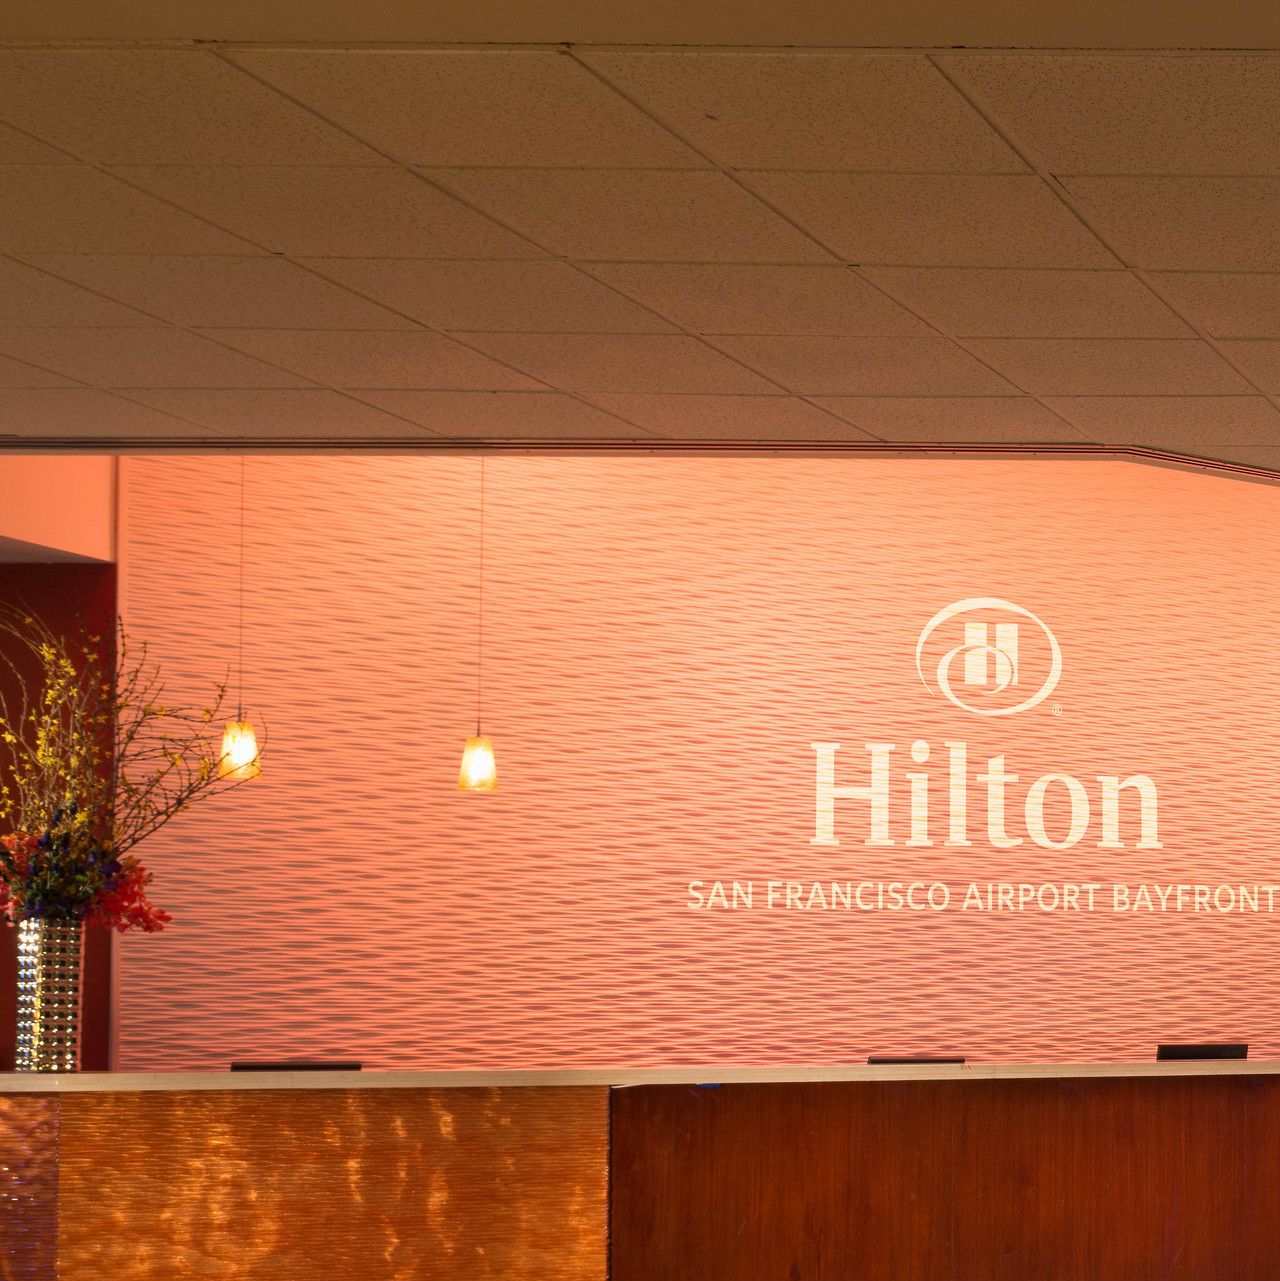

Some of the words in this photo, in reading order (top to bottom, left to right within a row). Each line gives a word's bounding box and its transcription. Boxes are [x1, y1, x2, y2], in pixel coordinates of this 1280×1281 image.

[809, 740, 1163, 849] Hilton
[687, 880, 753, 910] SAN
[767, 881, 951, 911] FRANCISCO
[962, 882, 1100, 912] AIRPORT
[1113, 884, 1280, 913] BAYFRONT
